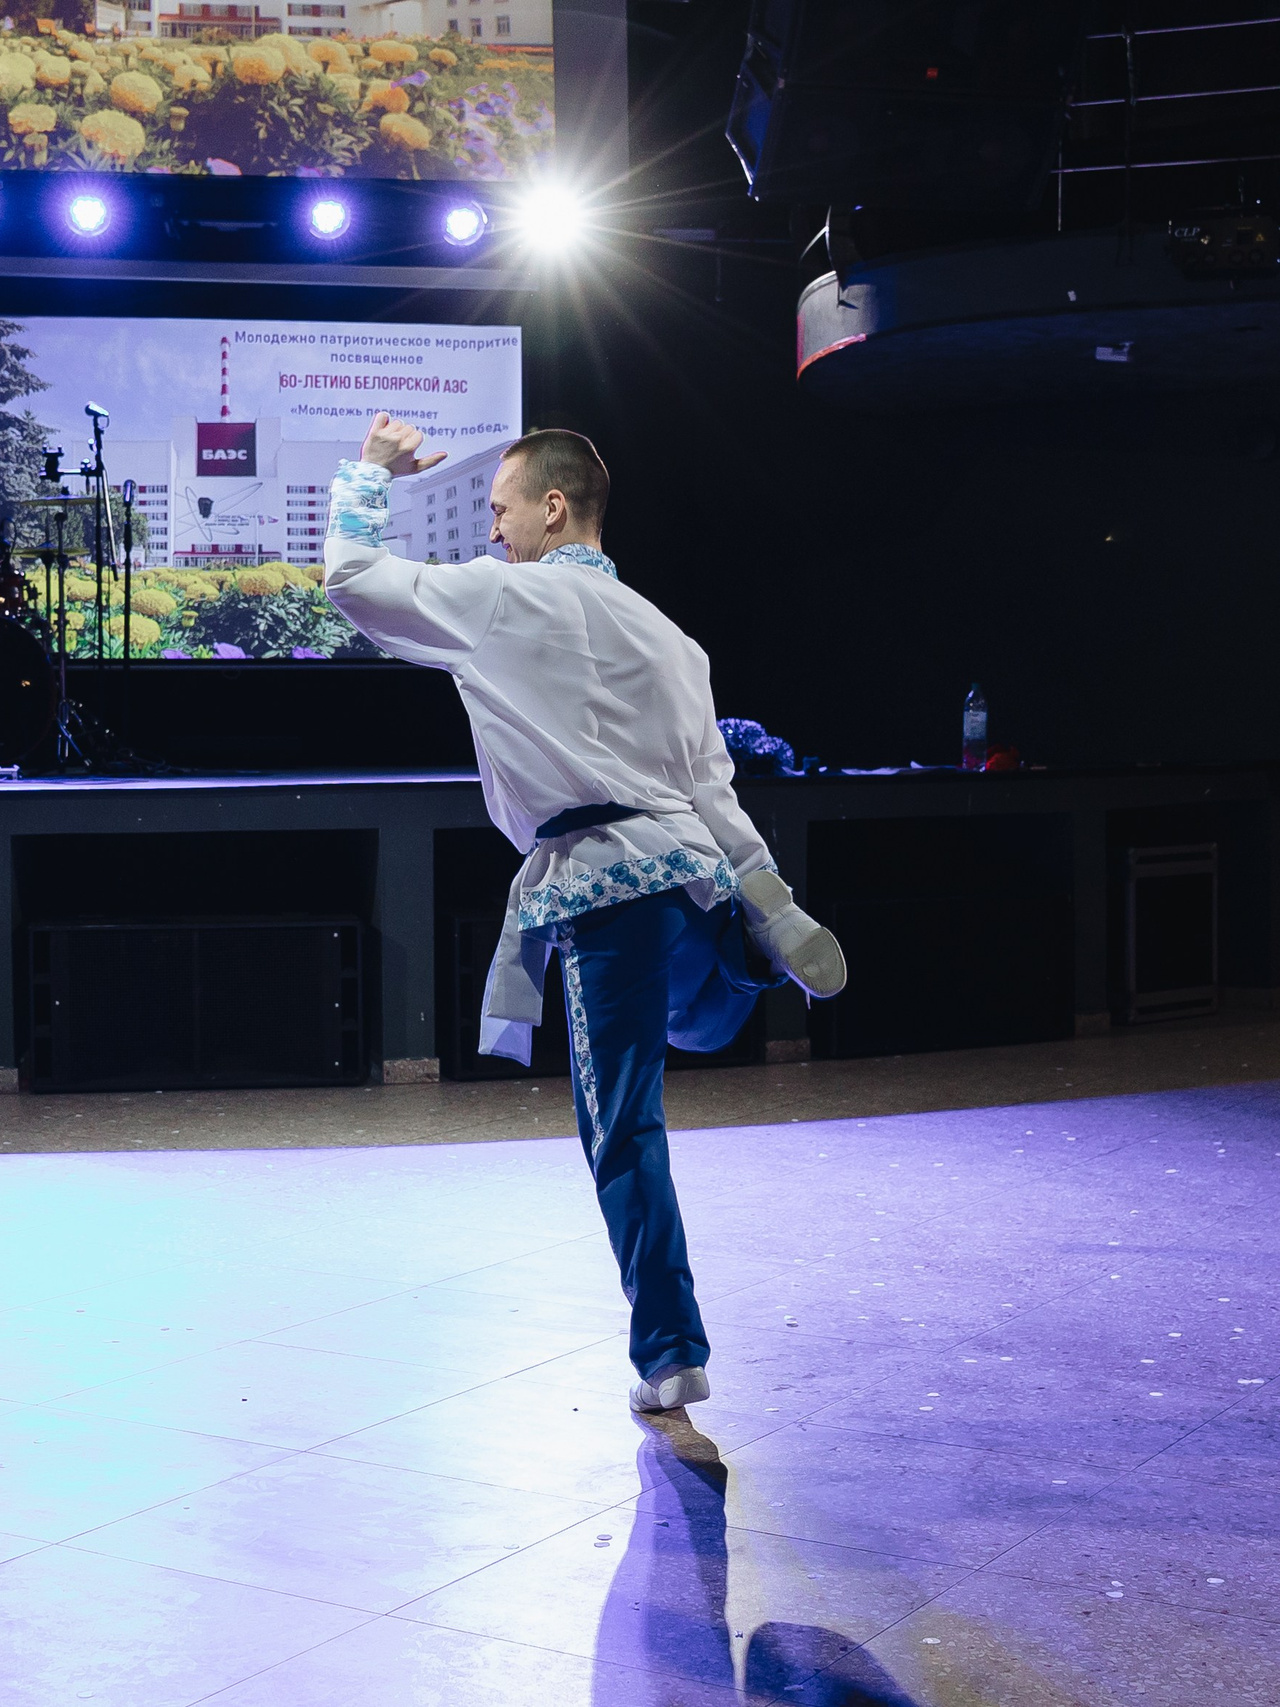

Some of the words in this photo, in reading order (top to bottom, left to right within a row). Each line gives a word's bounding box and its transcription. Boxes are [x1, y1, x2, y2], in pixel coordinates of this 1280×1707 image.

[235, 331, 316, 345] Молодежно
[320, 334, 431, 347] патриотическое
[435, 337, 518, 352] меропритие
[330, 353, 424, 365] посвященное
[280, 374, 351, 389] 60-ЛЕТИЮ
[354, 376, 440, 393] БЕЛОЯРСКОЙ
[442, 379, 468, 394] АЭС
[290, 404, 363, 417] «Молодежь
[460, 422, 509, 436] побед»
[202, 449, 248, 460] БАЭС
